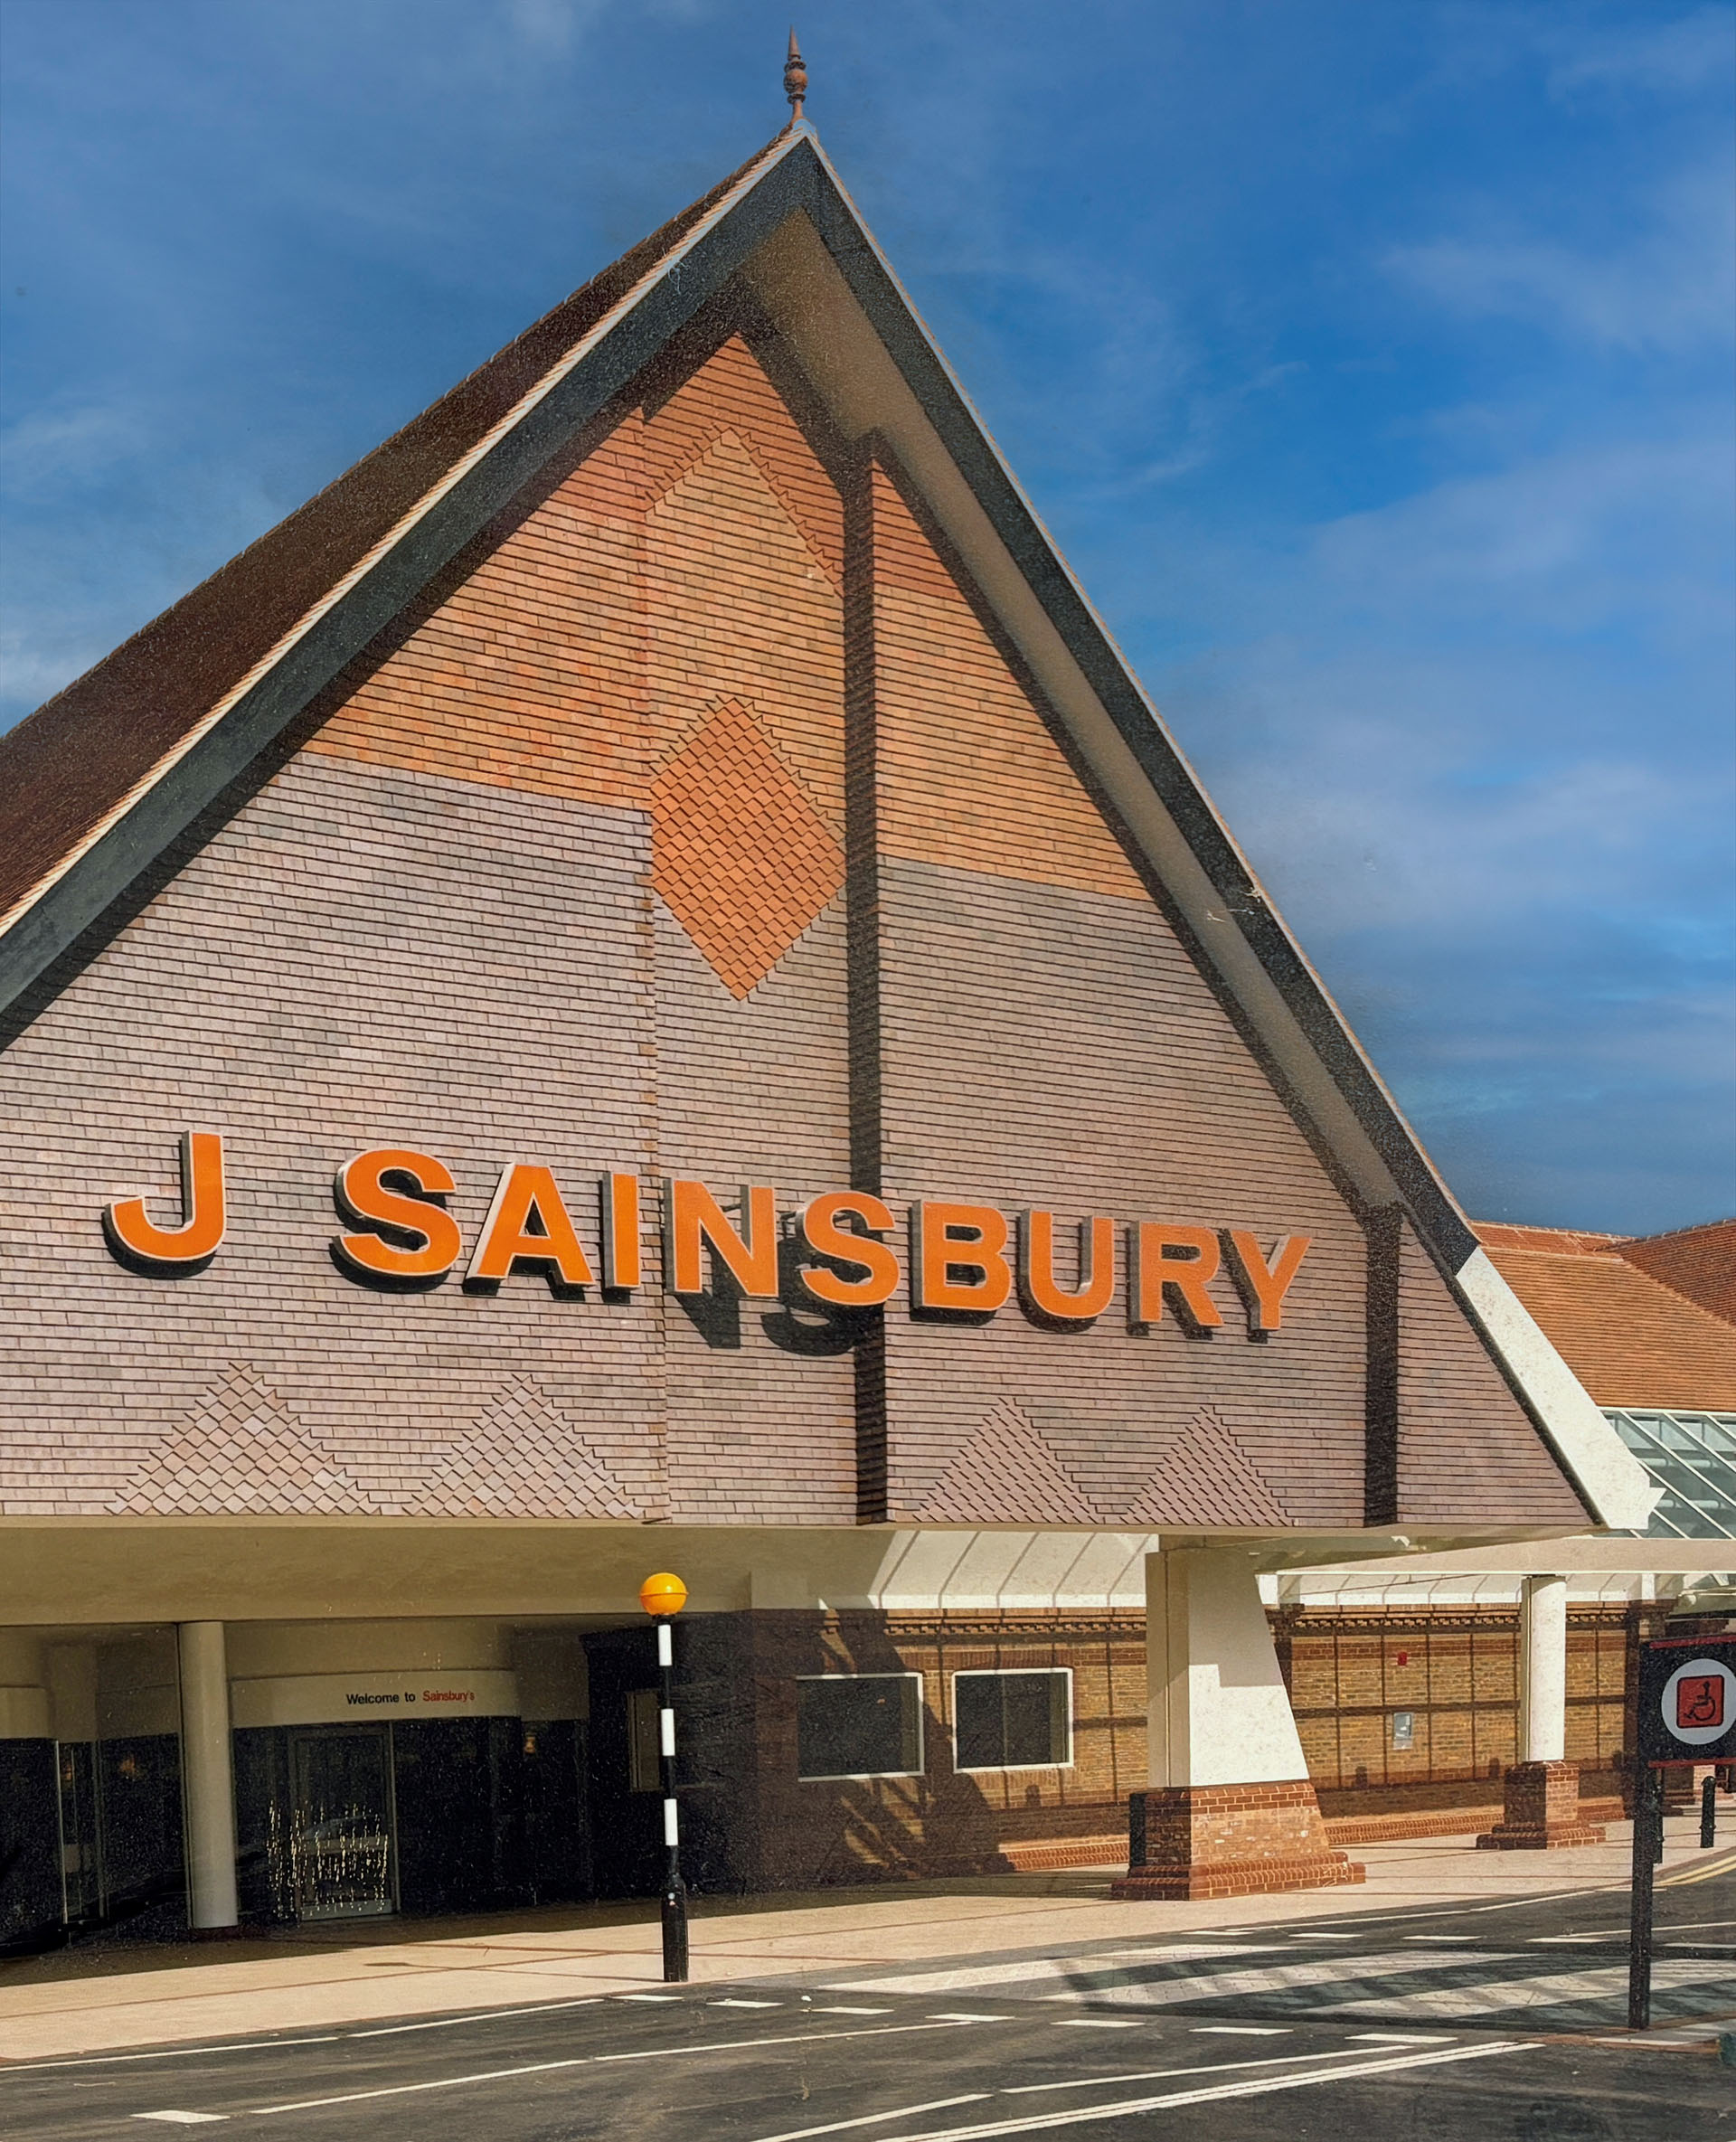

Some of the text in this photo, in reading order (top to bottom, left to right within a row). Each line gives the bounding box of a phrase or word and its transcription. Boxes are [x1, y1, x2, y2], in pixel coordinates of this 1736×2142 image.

[108, 1129, 1312, 1334] J SAINSBURY
[346, 1690, 476, 1705] Welcome to Sainsbury's
